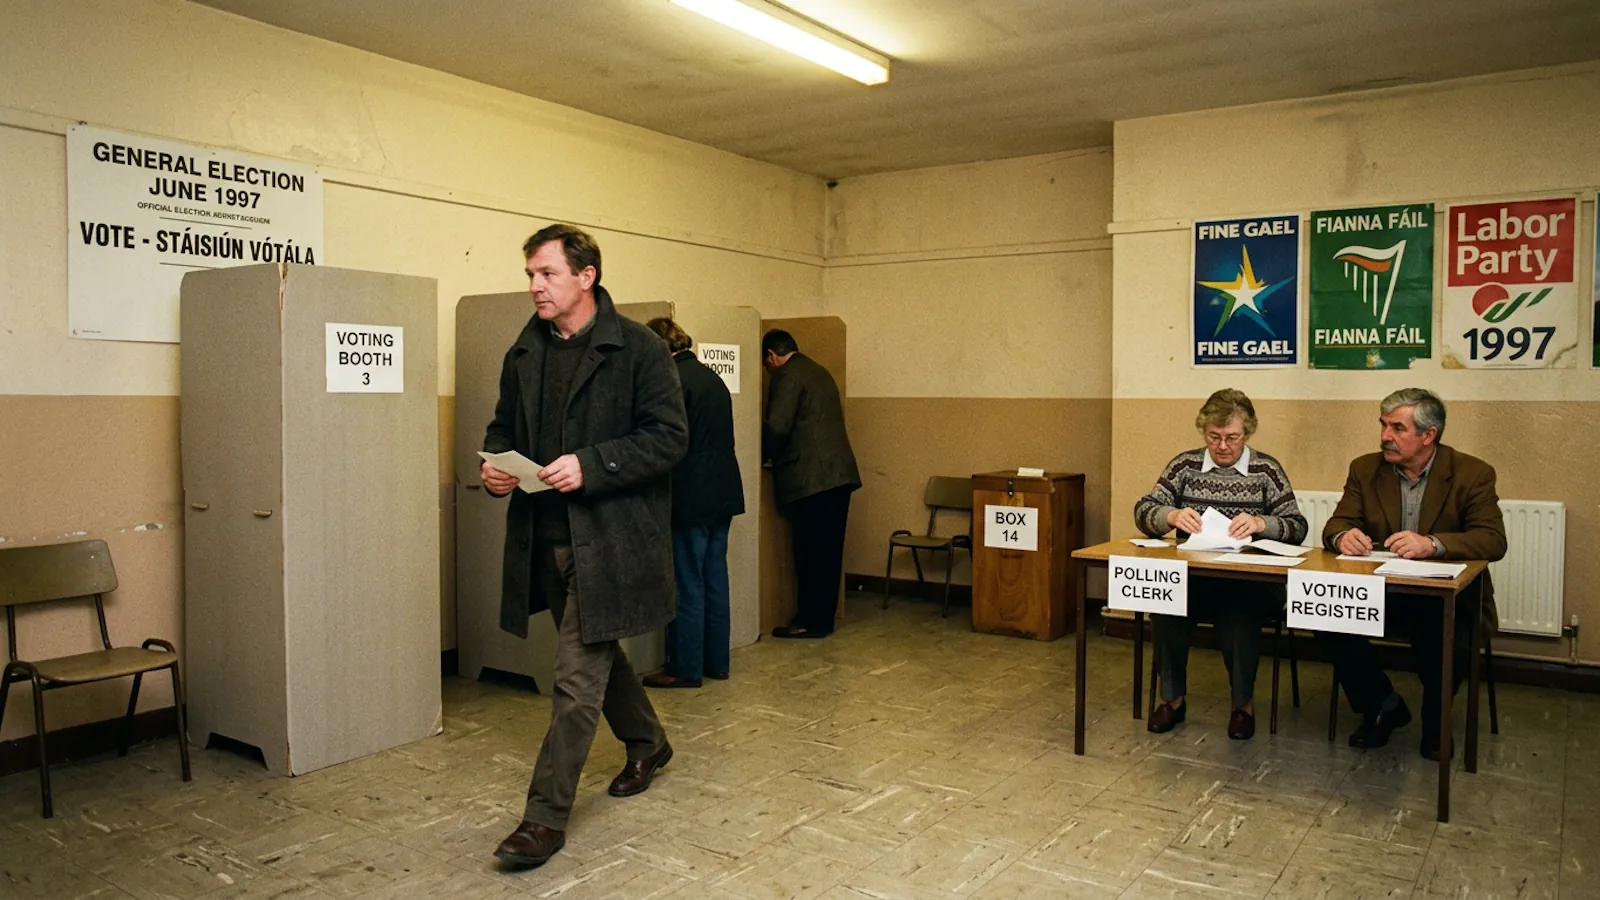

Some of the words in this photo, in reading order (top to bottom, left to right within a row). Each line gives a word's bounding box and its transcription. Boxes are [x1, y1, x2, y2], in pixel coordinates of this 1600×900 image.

[92, 141, 202, 177] GENERAL
[208, 160, 304, 193] ELECTION
[148, 177, 207, 202] JUNE
[214, 187, 261, 209] 1997
[136, 201, 173, 213] OFFICIAL
[1198, 223, 1240, 240] FINE
[1243, 219, 1295, 238] GAEL
[1317, 214, 1383, 234] FIANNA
[1388, 208, 1428, 229] FÁIL
[1458, 208, 1566, 242] Labor
[79, 220, 136, 250] VOTE
[156, 228, 244, 260] STÁISIÚN
[249, 236, 315, 265] VÓTÁLA
[1457, 245, 1559, 281] Party
[336, 331, 394, 348] VOTING
[1314, 328, 1381, 345] FIANNA
[1386, 323, 1426, 345] FÁIL
[1462, 326, 1556, 361] 1997
[1197, 340, 1239, 356] FINE
[1242, 340, 1294, 356] GAEL
[339, 351, 392, 366] BOOTH
[362, 372, 370, 386] 3
[995, 511, 1026, 526] BOX
[1002, 529, 1019, 542] 14
[1114, 566, 1181, 584] POLLING
[1121, 584, 1173, 602] CLERK
[1302, 582, 1369, 601] VOTING
[1291, 600, 1380, 622] REGISTER
